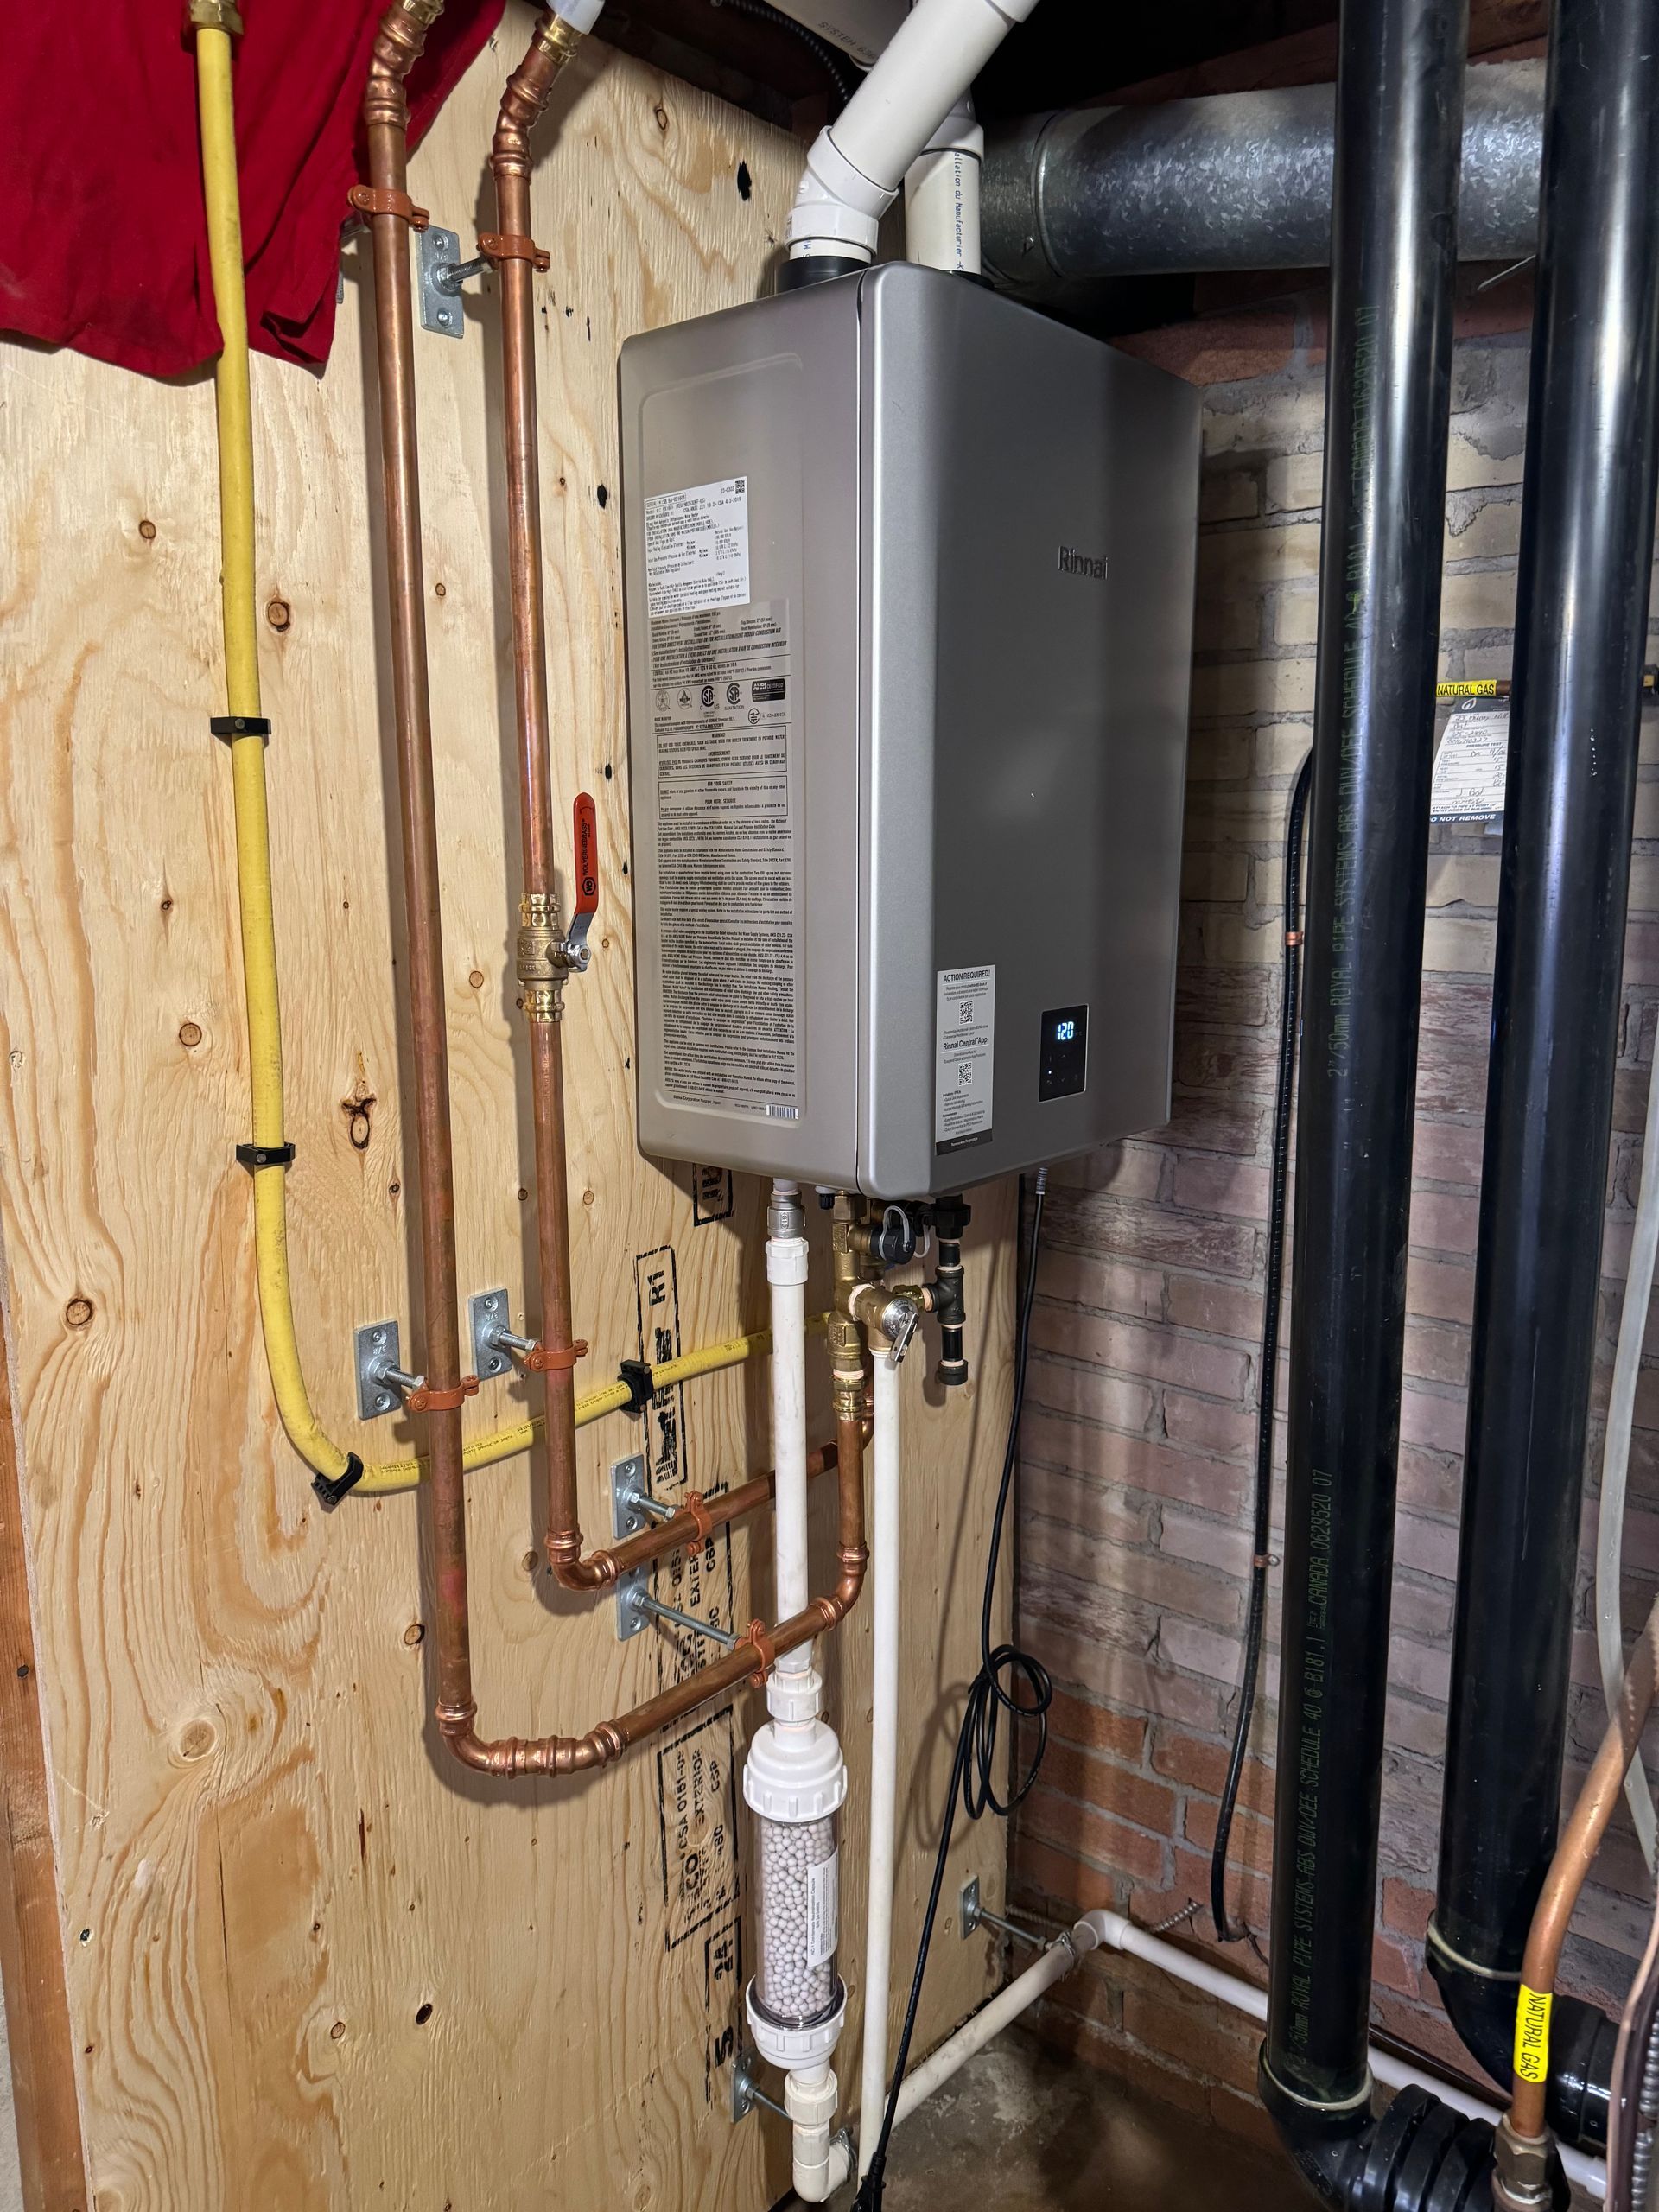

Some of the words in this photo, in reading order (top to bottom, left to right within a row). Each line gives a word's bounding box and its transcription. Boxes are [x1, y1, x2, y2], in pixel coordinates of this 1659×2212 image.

[818, 22, 856, 46] SYSTEM
[954, 151, 963, 187] allation
[1058, 546, 1108, 580] Rinnai
[1438, 684, 1475, 695] NATURAL
[1476, 684, 1495, 695] GAS
[1334, 841, 1358, 906] SYSTEMS
[1332, 915, 1355, 952] PIPE
[944, 973, 963, 982] ACTION
[1329, 961, 1352, 1007] ROYAL
[1058, 1021, 1074, 1040] 120
[1312, 1469, 1332, 1486] 07
[1310, 1494, 1332, 1550] 0629520
[1308, 1557, 1330, 1605] CANADA
[1305, 1637, 1327, 1682] B181.1
[1303, 1704, 1323, 1721] 40
[1300, 1725, 1322, 1788] SCHEDULE
[693, 1749, 705, 1828] EXTERIOR
[1295, 1851, 1316, 1877] ABS
[1294, 1879, 1315, 1932] SYSTEMS
[1292, 1936, 1312, 1967] PIPE
[1291, 1974, 1311, 2010] ROYAL
[1522, 1993, 1546, 2054] NATURAL
[1520, 2053, 1540, 2079] GAS
